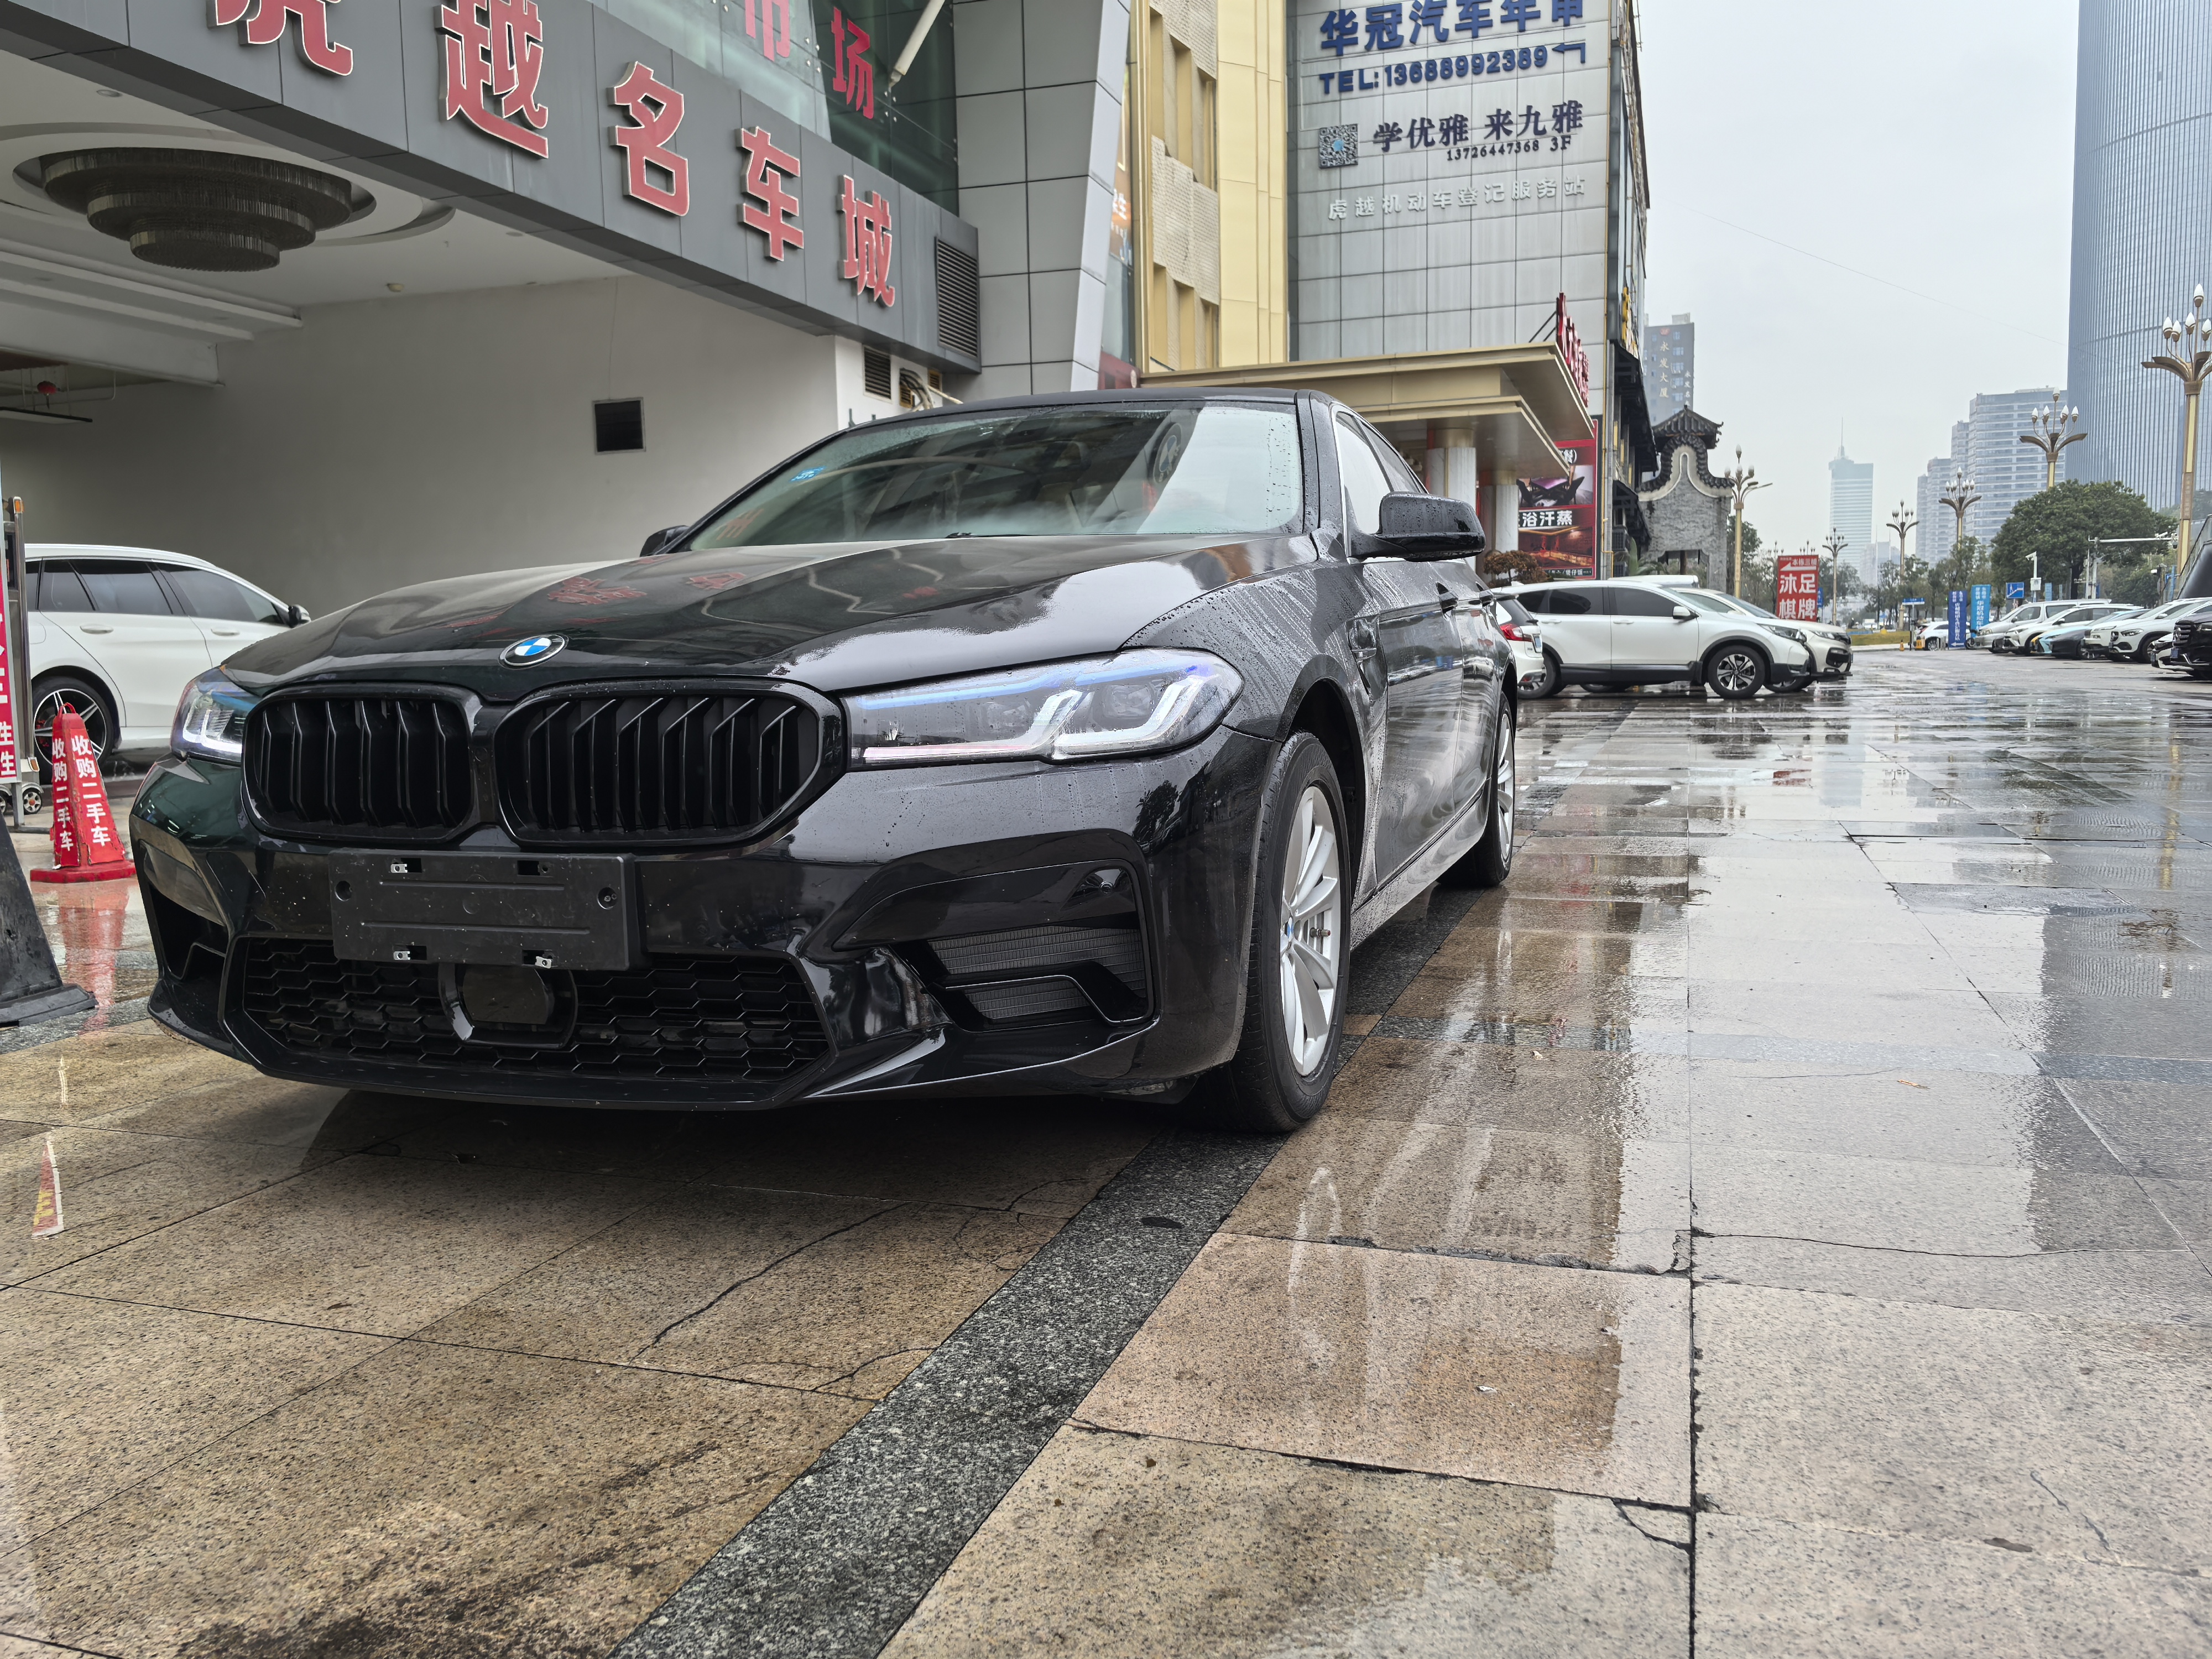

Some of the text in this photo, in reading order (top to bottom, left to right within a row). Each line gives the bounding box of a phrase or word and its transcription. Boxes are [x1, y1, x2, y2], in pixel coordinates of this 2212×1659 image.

[1373, 100, 1583, 152] 学优雅 来九雅
[1446, 135, 1571, 161] 13726447368 3F
[1328, 175, 1585, 221] 虎越机动车登记服务站
[1518, 510, 1572, 527] 浴汗蒸
[1780, 573, 1816, 594] 沐足
[1779, 598, 1815, 619] 棋牌
[52, 738, 74, 851] 收购二手车
[71, 735, 111, 847] 收购二手车
